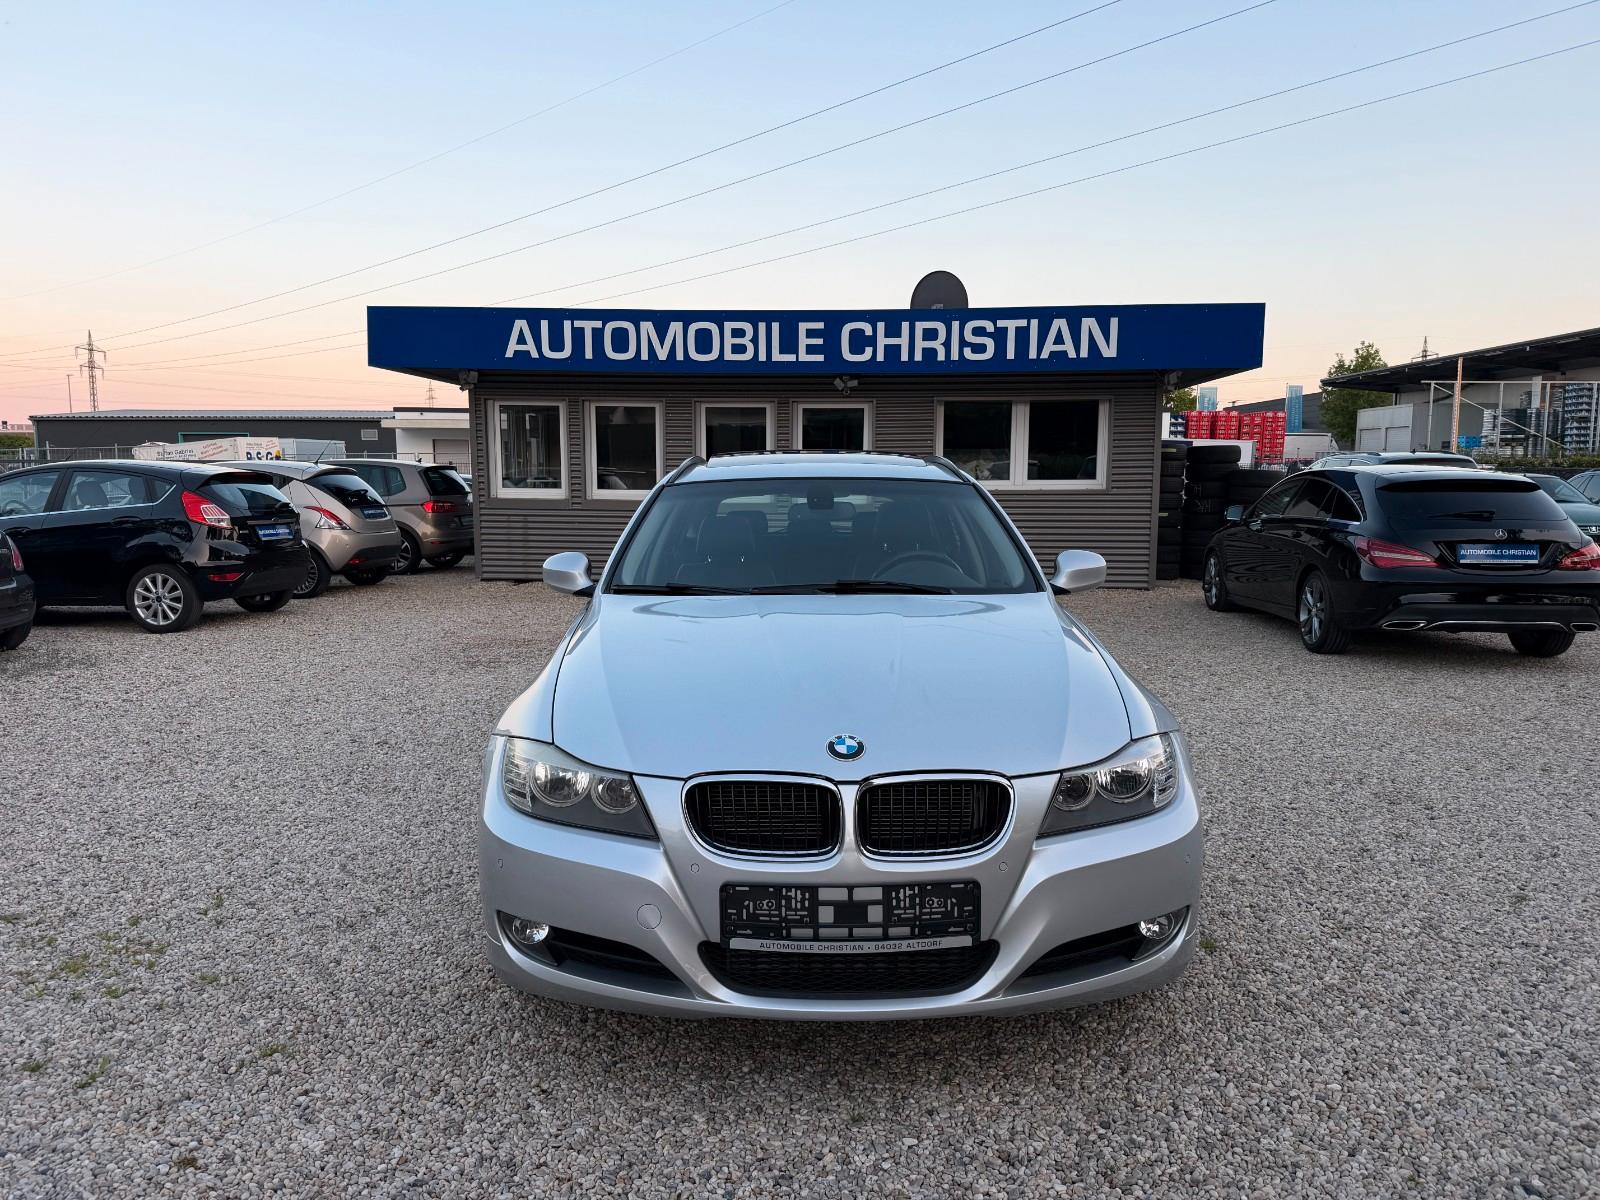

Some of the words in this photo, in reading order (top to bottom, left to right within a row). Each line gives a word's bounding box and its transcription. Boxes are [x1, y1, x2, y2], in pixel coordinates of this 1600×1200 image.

[504, 319, 825, 362] AUTOMOBILE
[840, 317, 1119, 362] CHRISTIAN
[759, 941, 814, 951] AUTOMOBILE
[906, 940, 943, 949] ALTDORF
